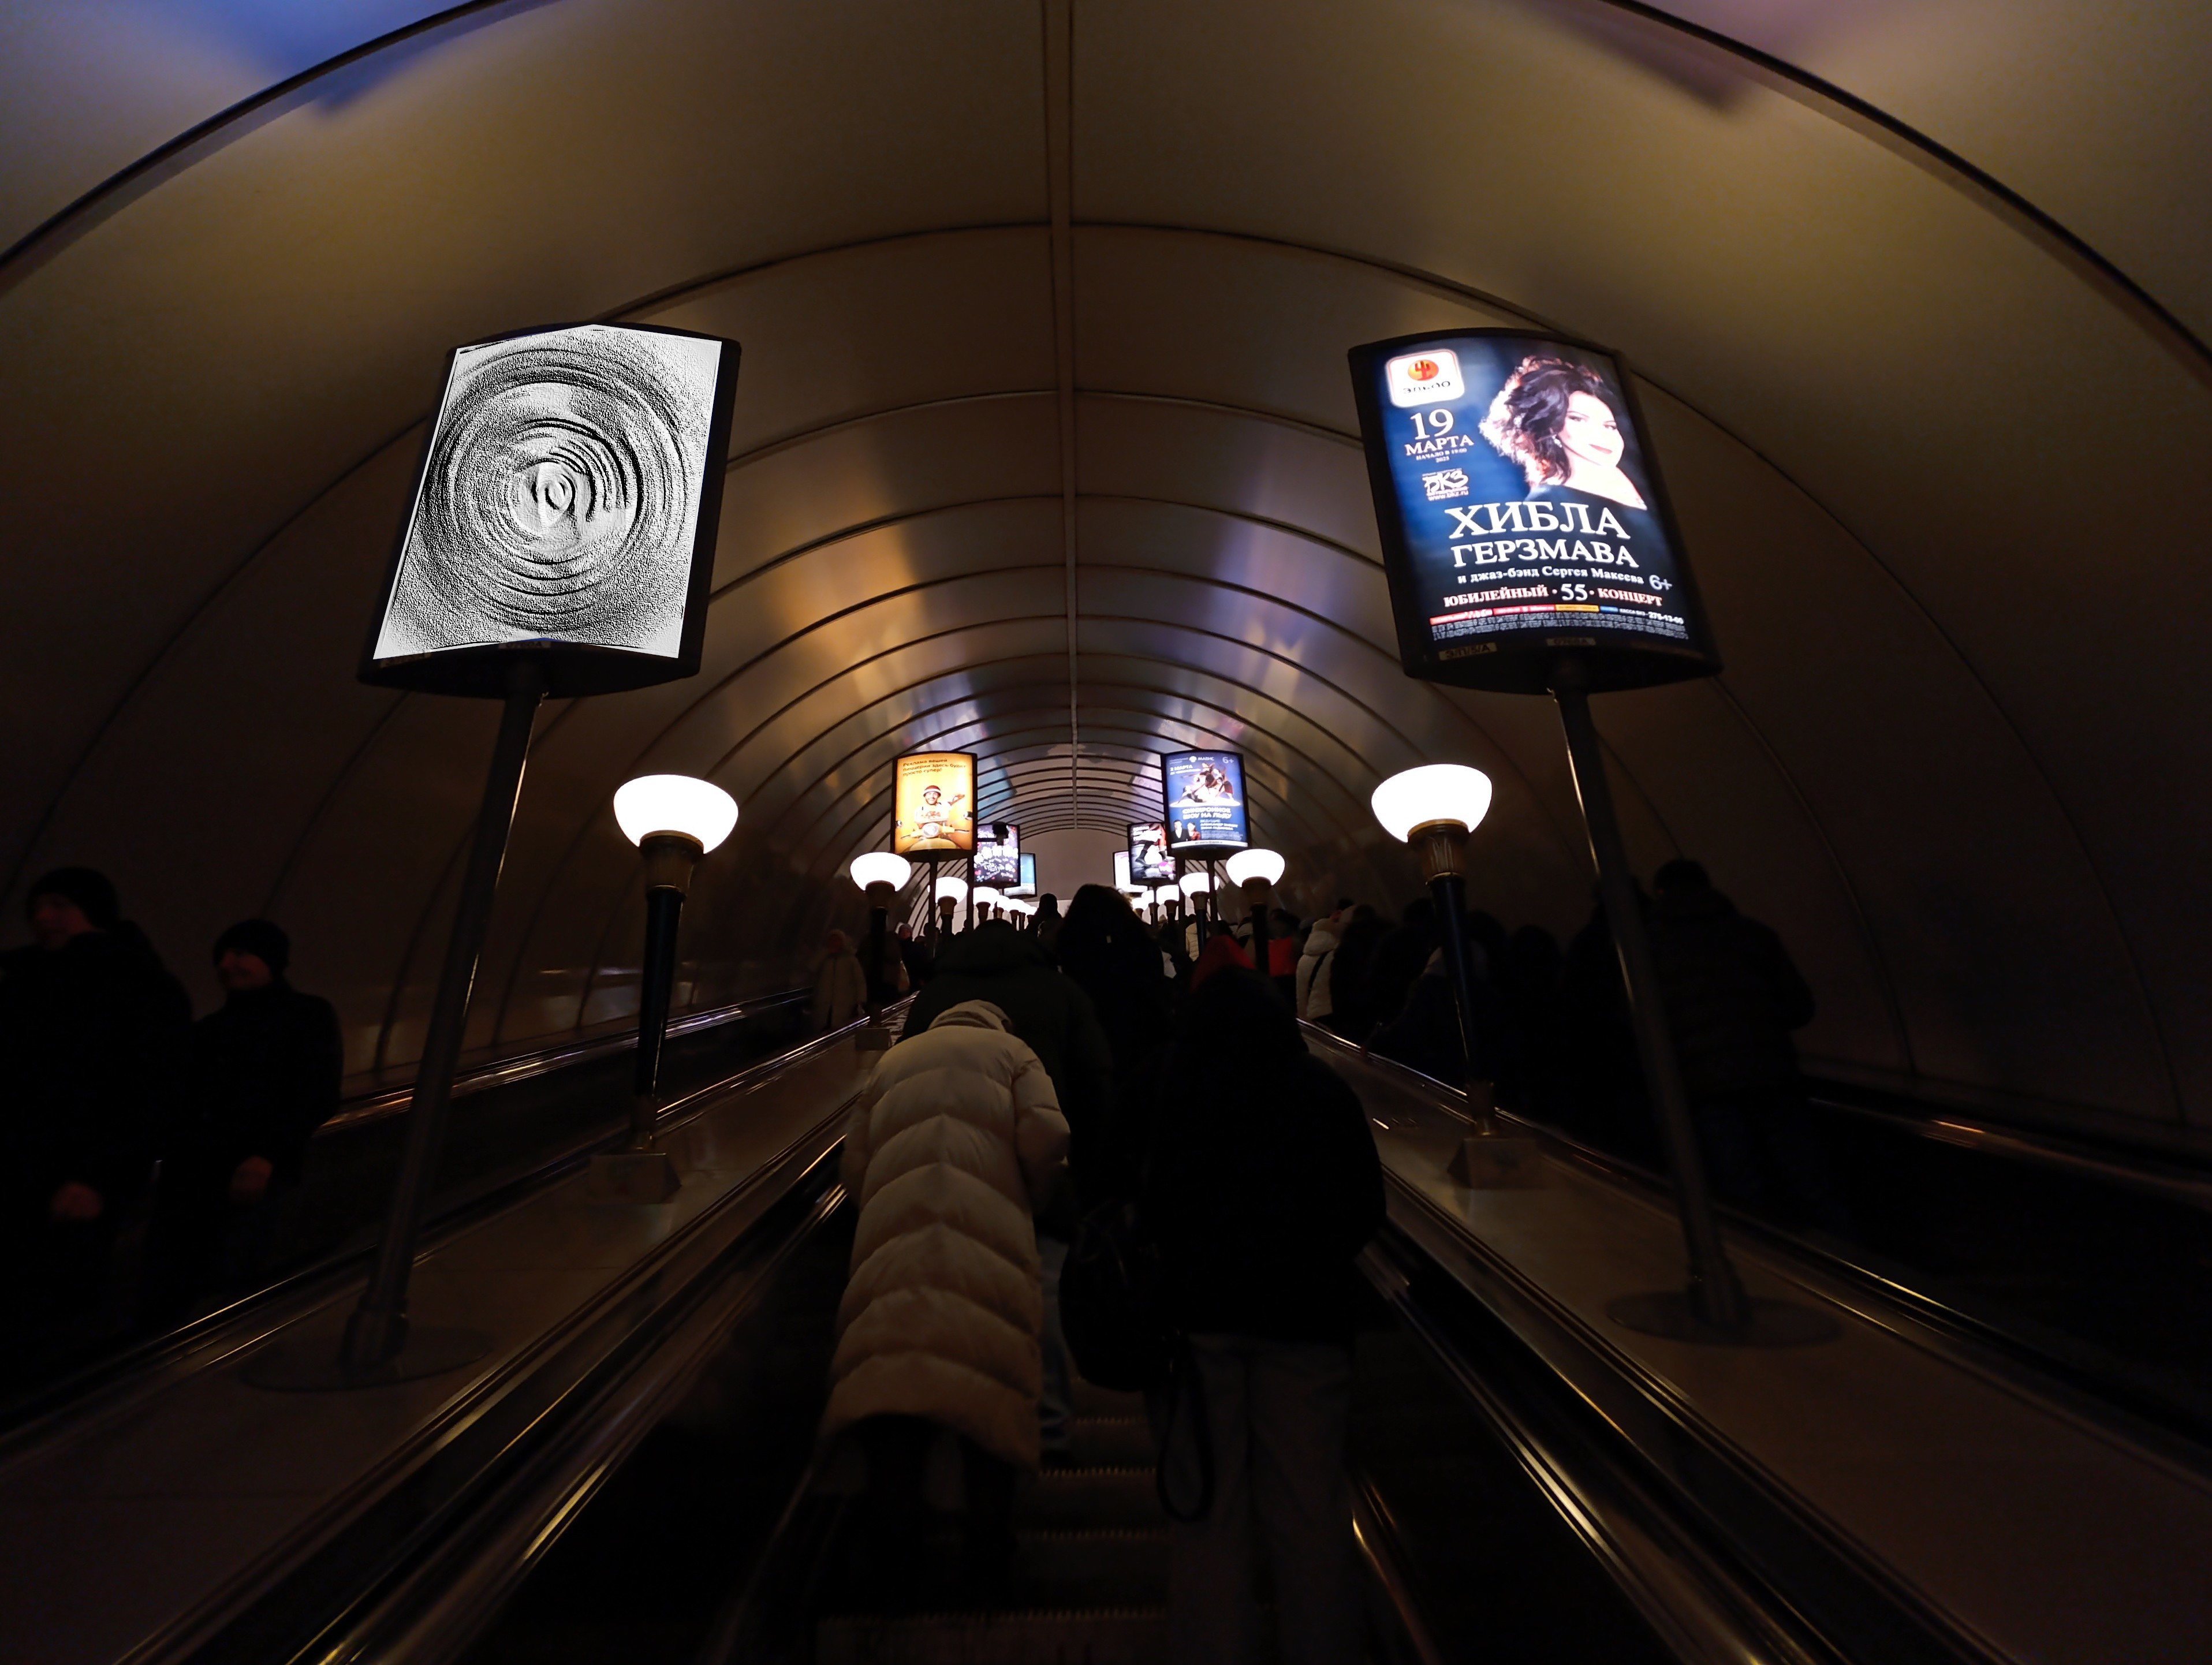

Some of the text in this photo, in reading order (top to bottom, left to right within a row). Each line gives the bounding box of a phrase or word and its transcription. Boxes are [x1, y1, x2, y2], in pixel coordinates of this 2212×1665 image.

[1410, 409, 1454, 440] 19
[1404, 434, 1474, 456] МАРТА
[1416, 450, 1444, 460] НАЧАЛО
[1444, 501, 1631, 540] ХИБЛА
[1450, 538, 1639, 568] ГЕРЗМАВА
[1458, 566, 1644, 584] и джаз-бэнд Сергея Макеева
[1648, 574, 1673, 591] 6+
[1443, 583, 1663, 607] ЮБИЛЕЙНЫЙ 55 КОНЦЕРТ
